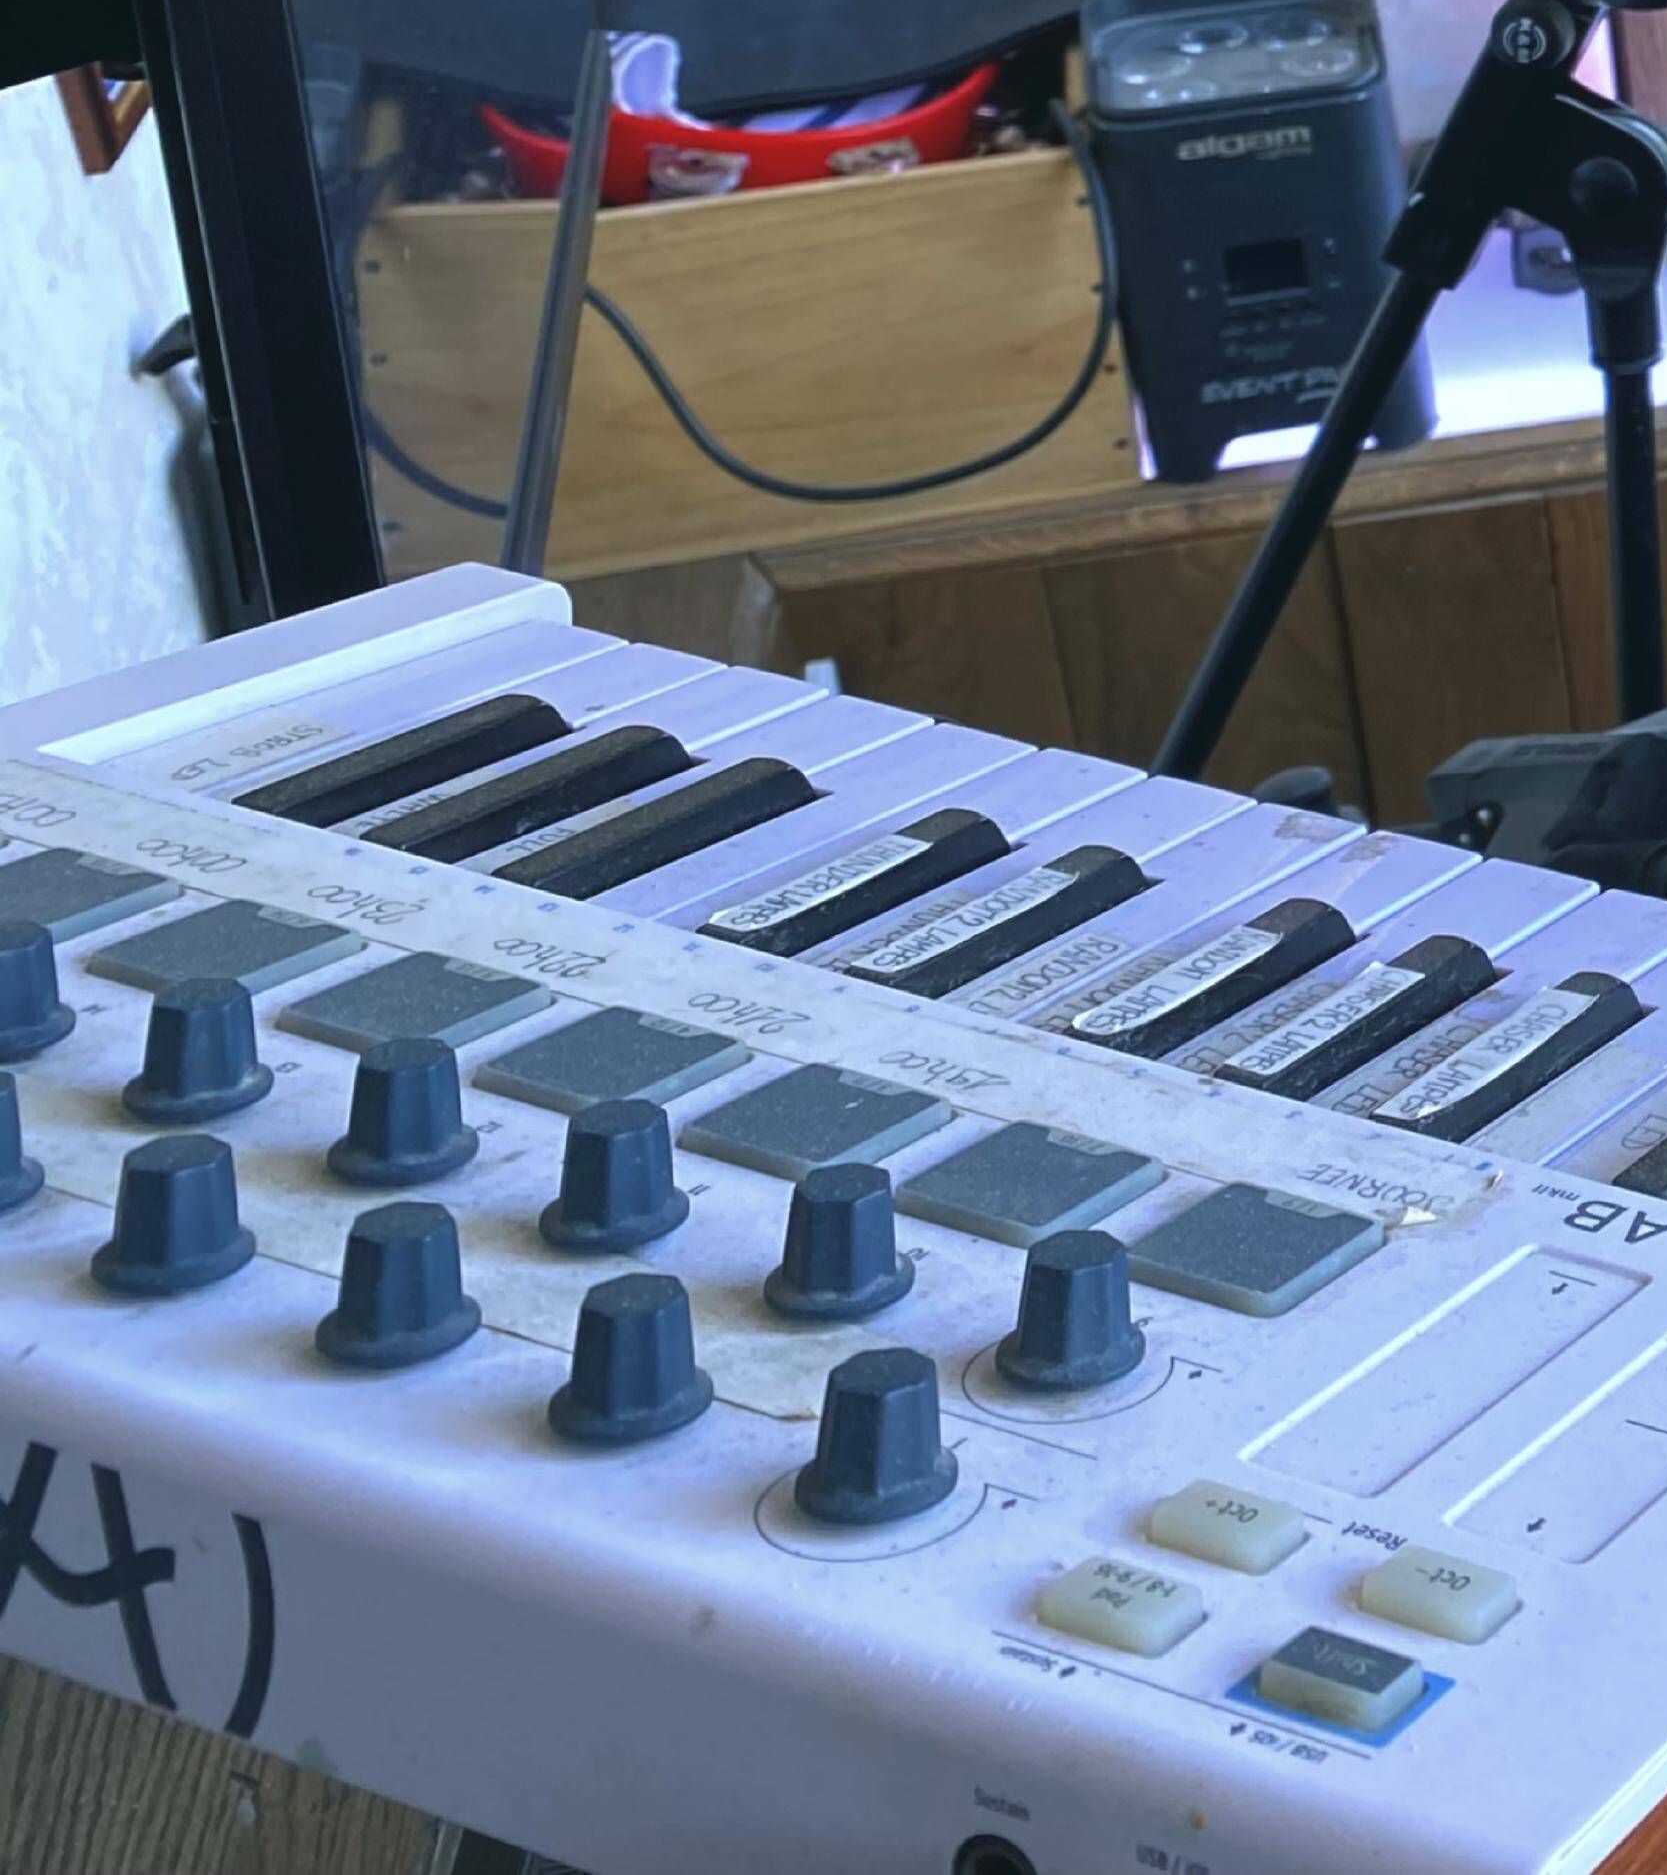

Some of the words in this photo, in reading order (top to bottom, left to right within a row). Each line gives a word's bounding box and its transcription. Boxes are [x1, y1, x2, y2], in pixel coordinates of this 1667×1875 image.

[1177, 125, 1311, 161] algam
[493, 938, 607, 979] 22h00
[686, 991, 811, 1036] 21h00
[1476, 1003, 1567, 1055] CHASER
[1340, 1520, 1409, 1552] Reset
